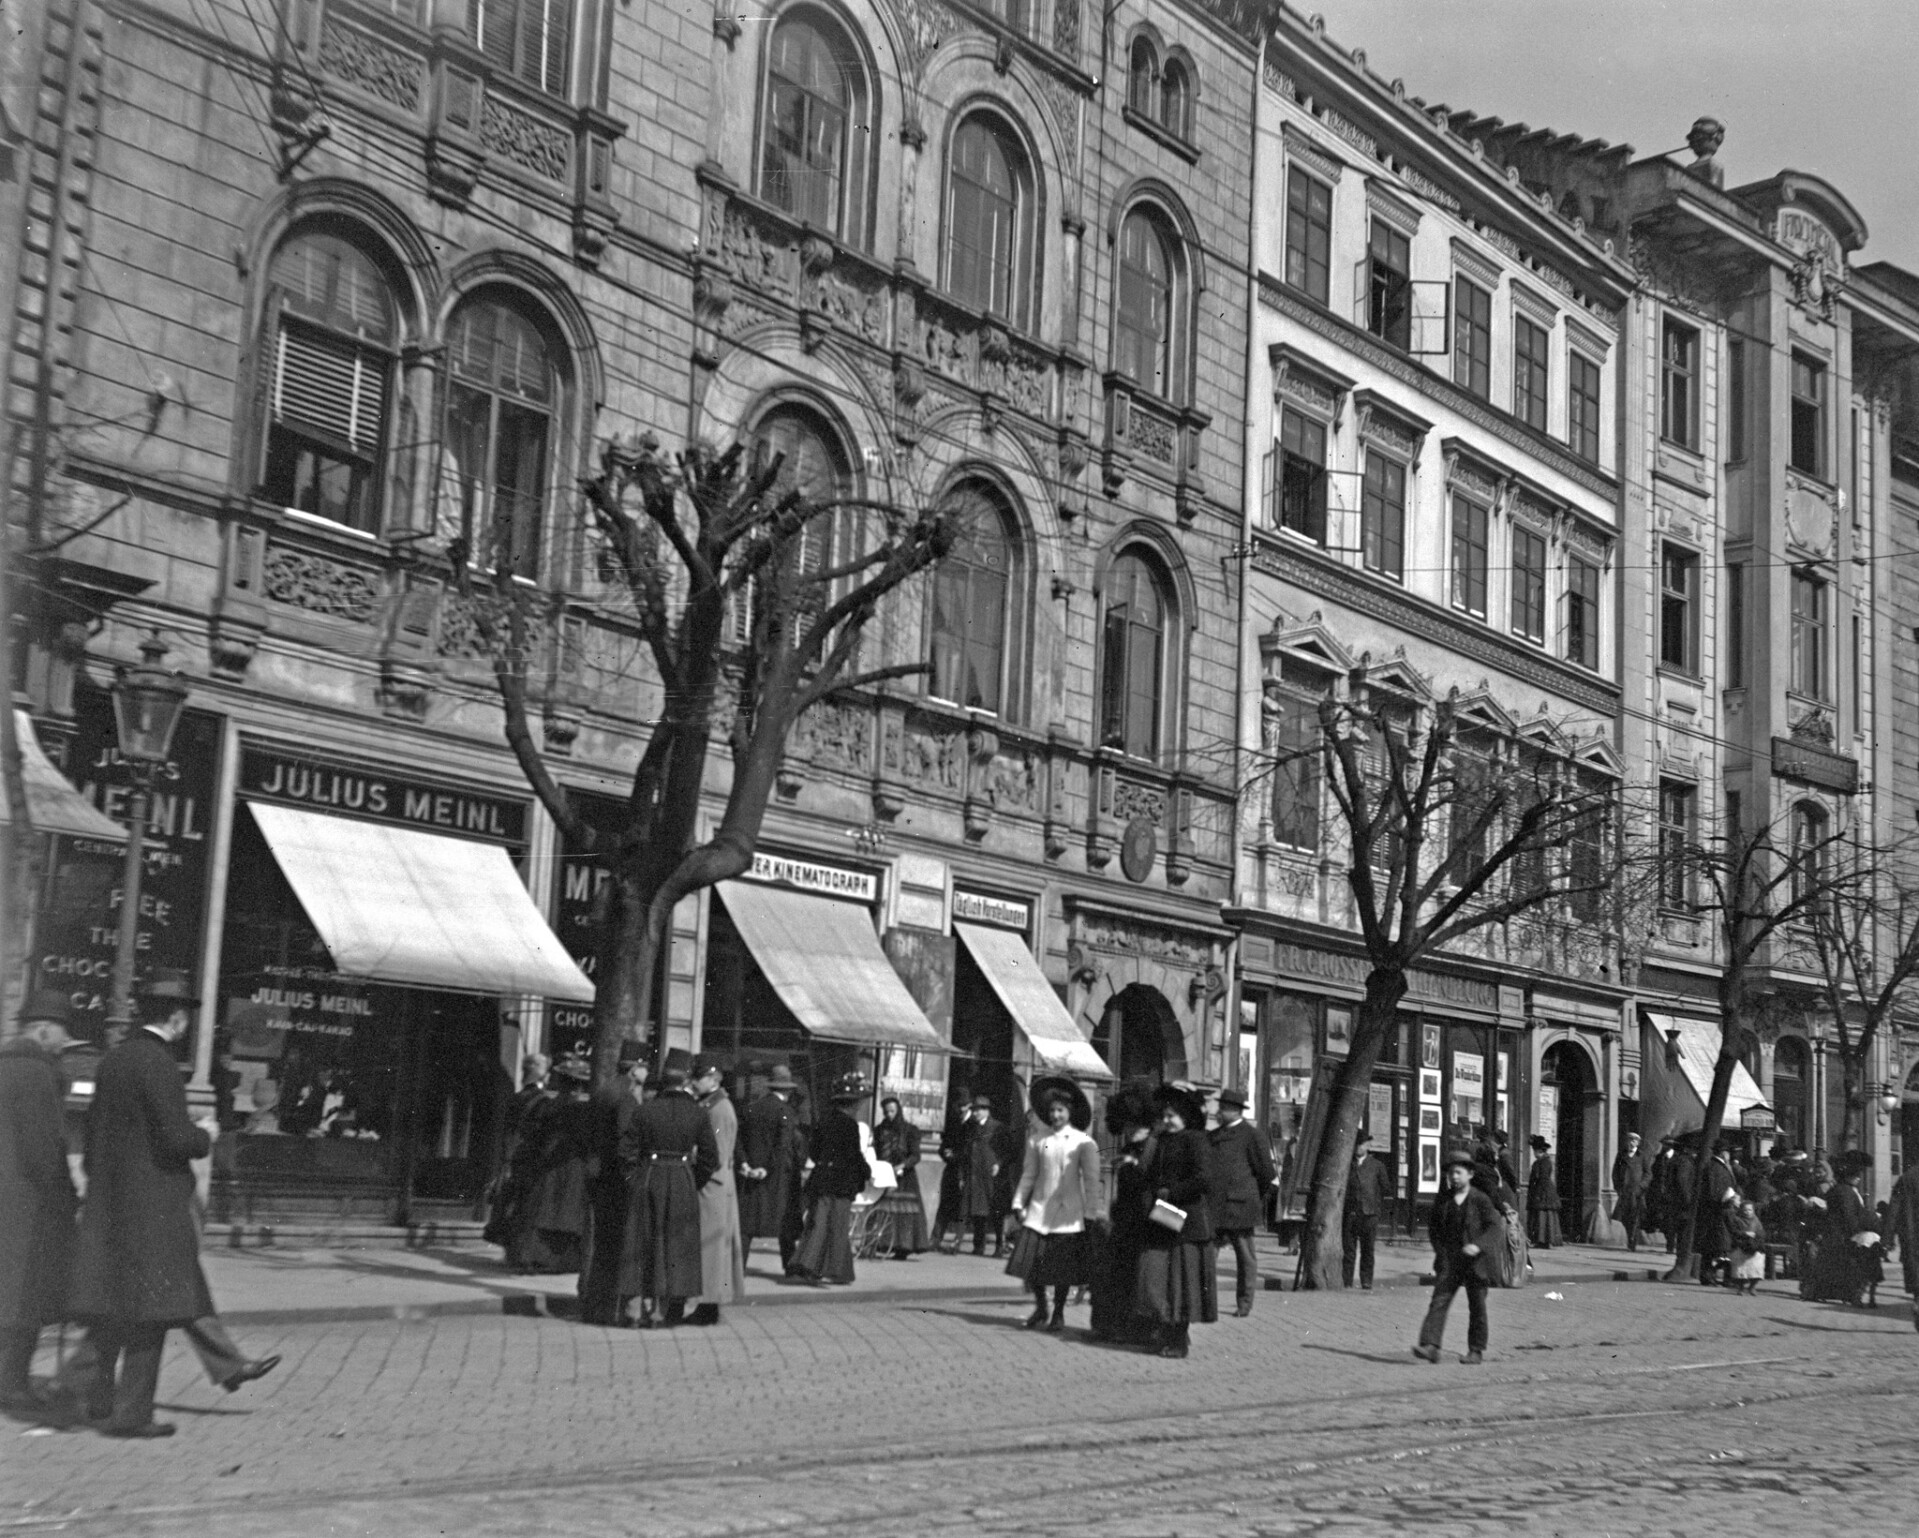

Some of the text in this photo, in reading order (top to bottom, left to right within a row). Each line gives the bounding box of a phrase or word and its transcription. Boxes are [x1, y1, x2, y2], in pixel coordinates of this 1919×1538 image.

[82, 780, 203, 841] ENL
[261, 764, 505, 835] JULIUS MEINL
[773, 861, 869, 896] KINEMATOGRAPH
[91, 927, 152, 950] THE
[251, 987, 372, 1016] JULIUS MEINL
